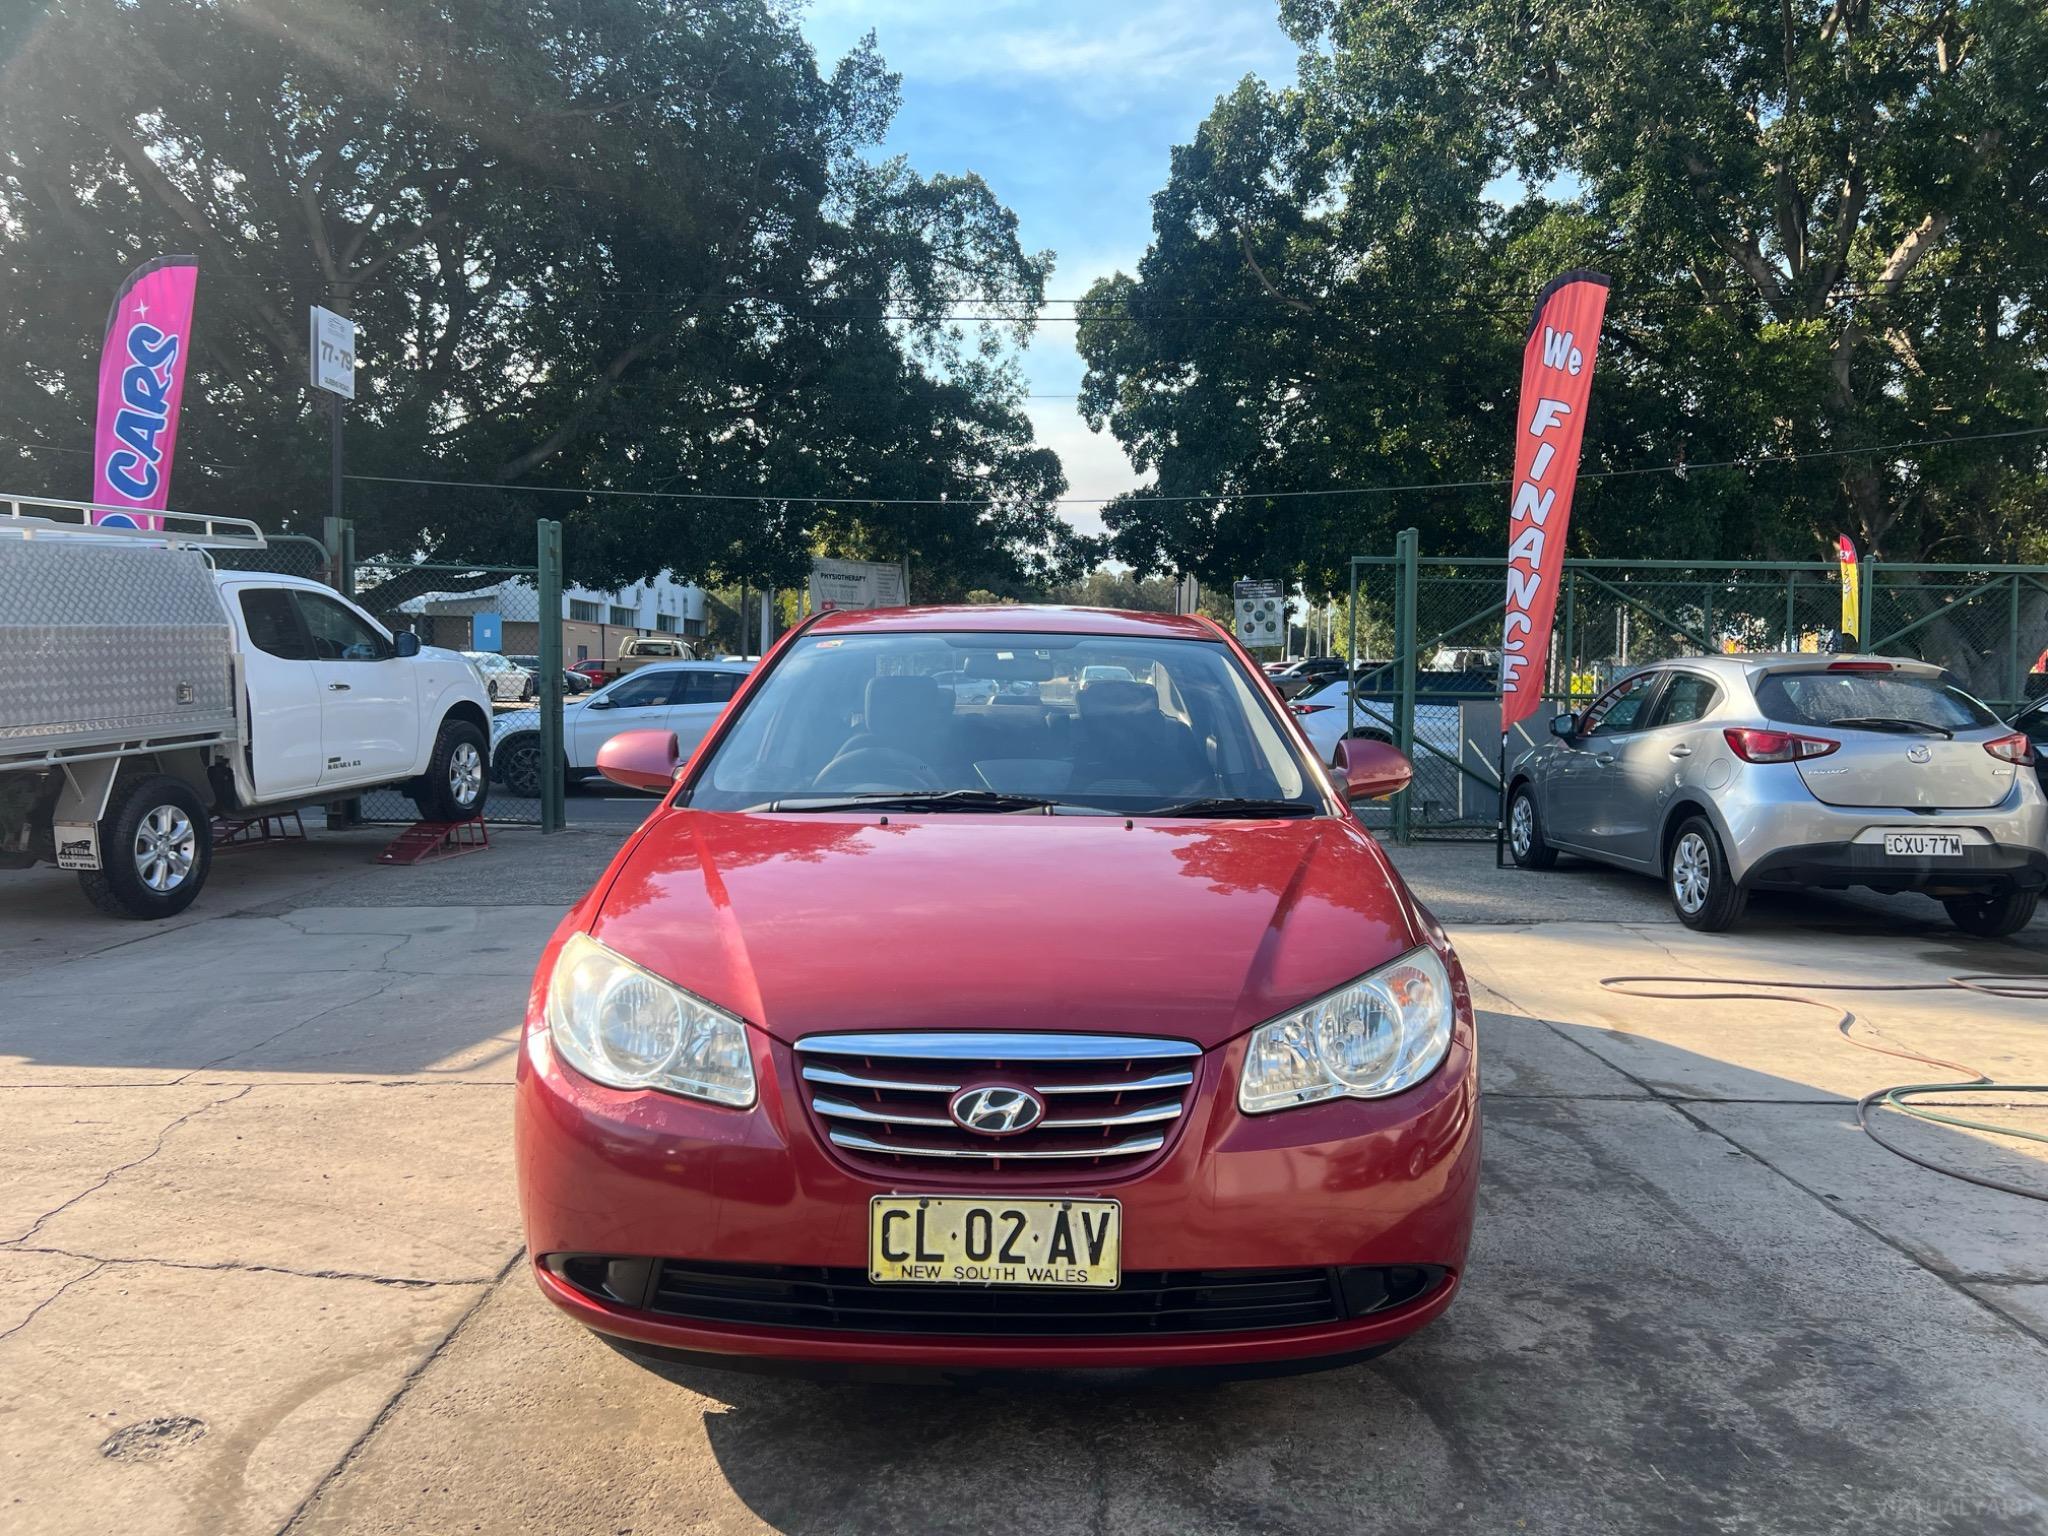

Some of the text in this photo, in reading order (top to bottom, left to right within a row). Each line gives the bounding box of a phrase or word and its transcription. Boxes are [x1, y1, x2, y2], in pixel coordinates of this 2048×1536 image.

[1543, 326, 1583, 376] We
[106, 323, 179, 500] CARS
[1503, 397, 1572, 692] FINANCE
[821, 573, 866, 582] PHYSIOTHERAPY
[901, 1265, 1088, 1282] NEW SOUTH WALES
